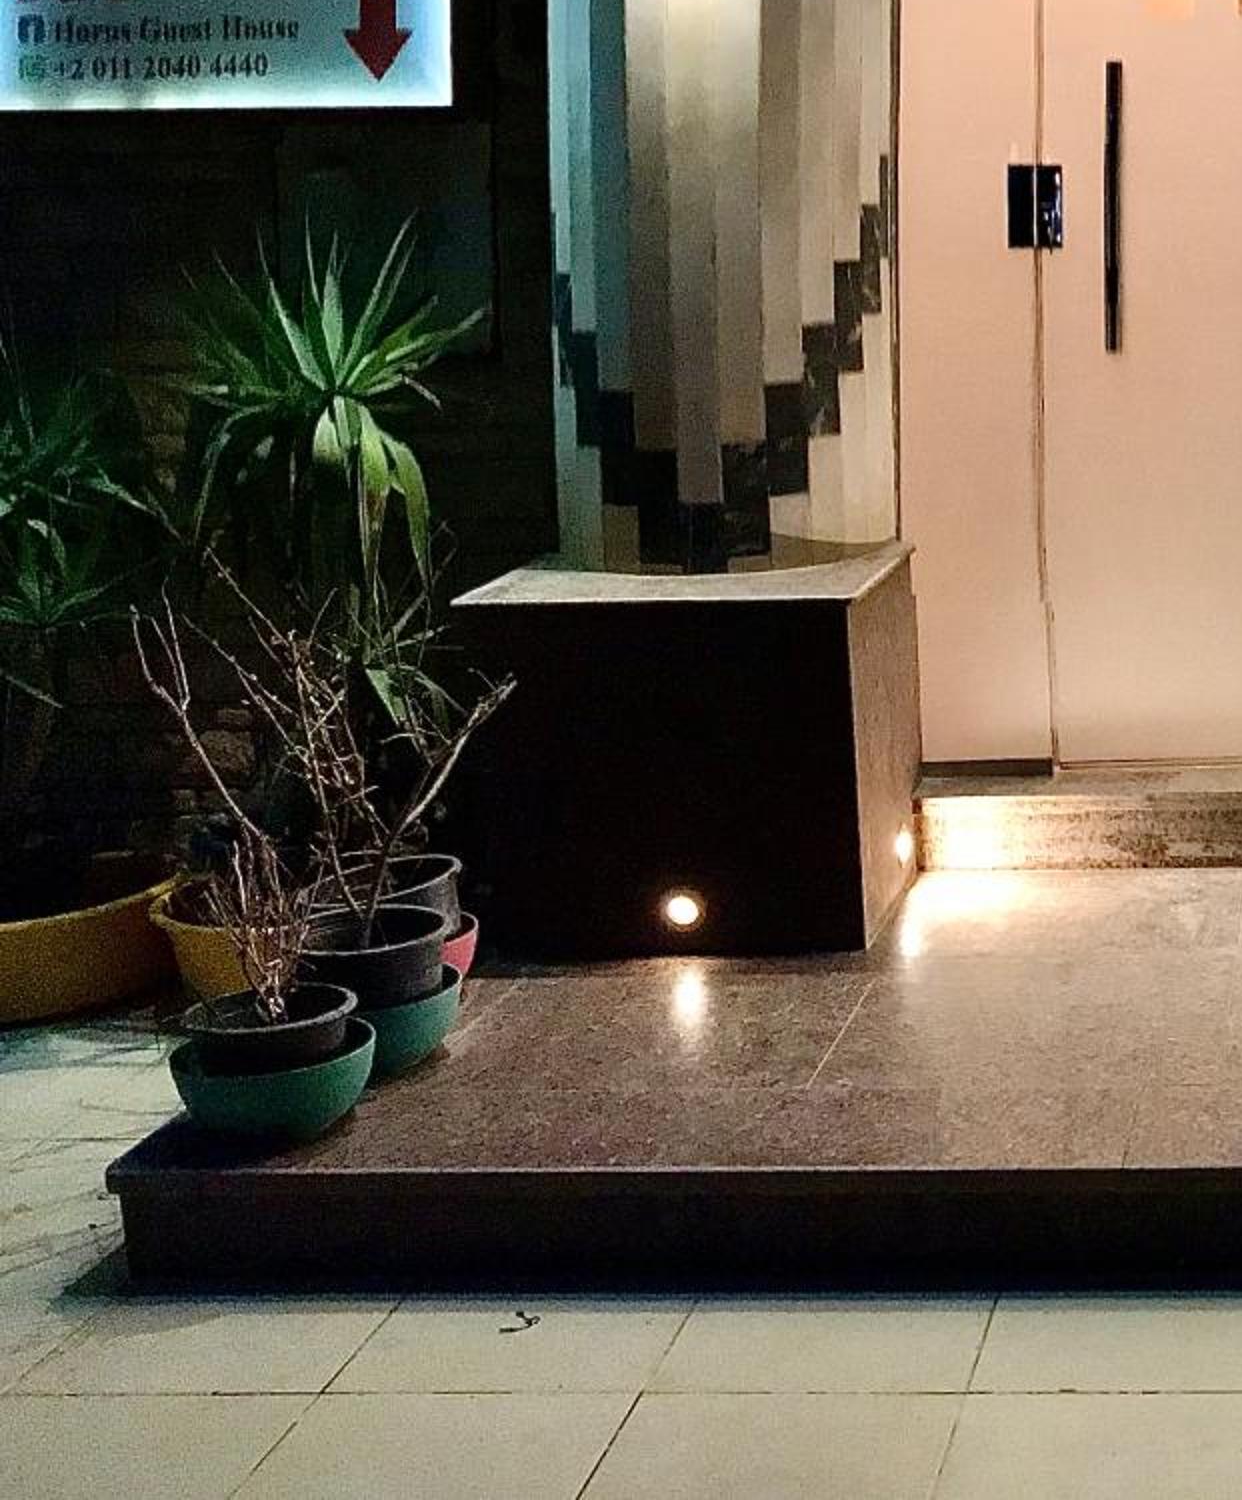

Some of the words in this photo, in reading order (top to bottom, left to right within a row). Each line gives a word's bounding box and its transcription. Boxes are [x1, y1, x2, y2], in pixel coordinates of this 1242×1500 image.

[55, 15, 132, 43] Horus
[140, 15, 212, 42] Guest
[222, 14, 300, 41] House
[92, 55, 132, 80] 011
[143, 53, 201, 80] 2040
[209, 52, 269, 78] 4440
